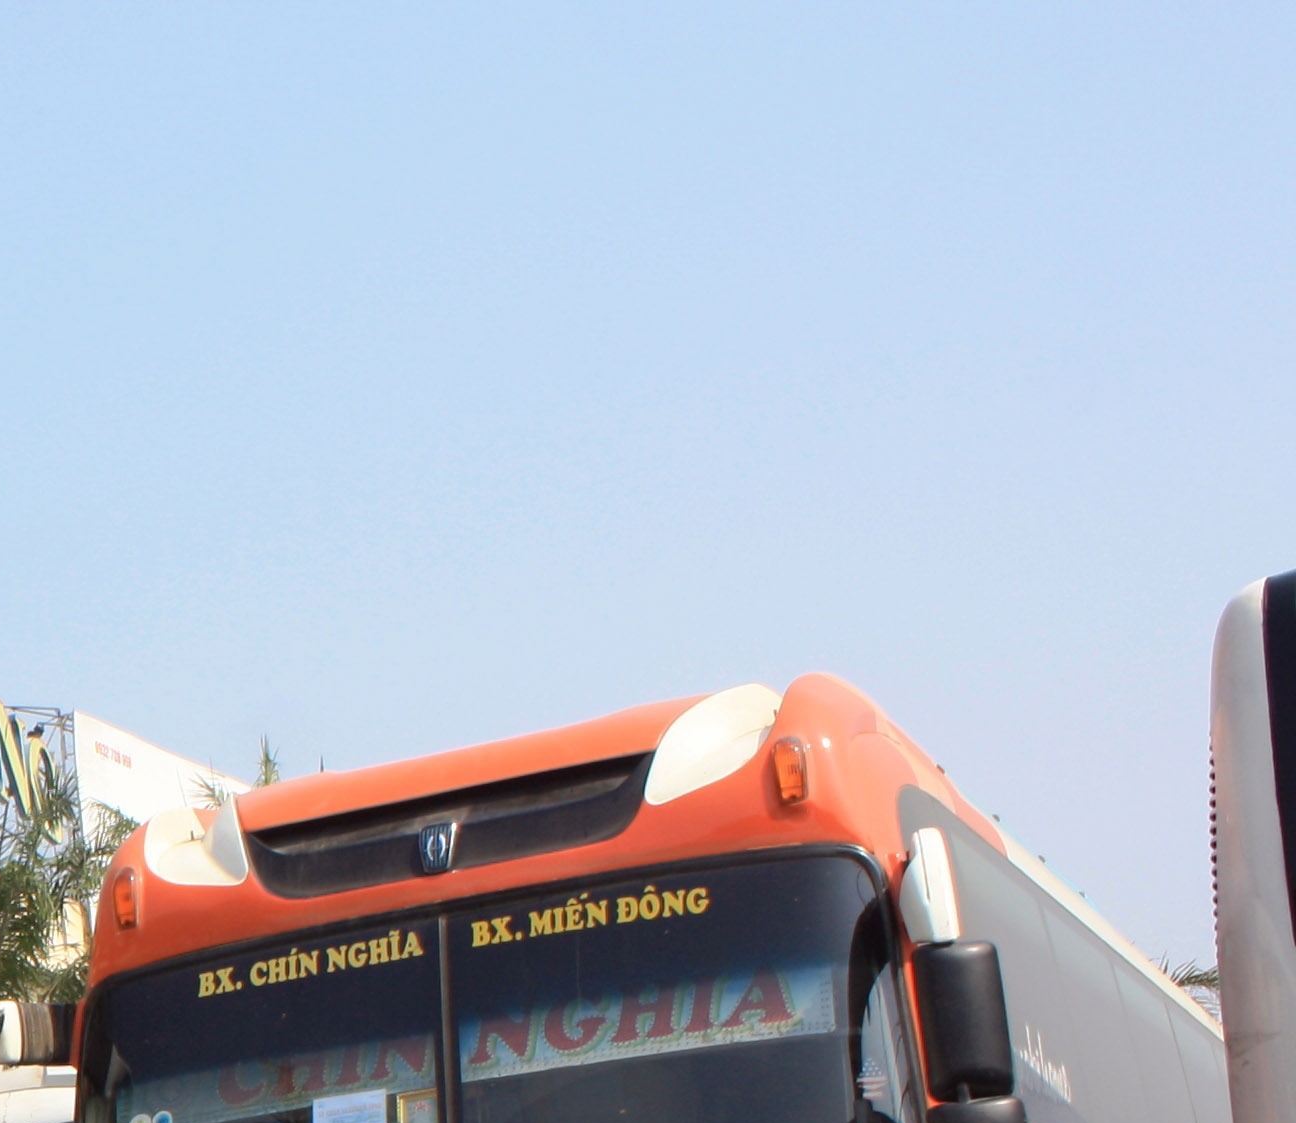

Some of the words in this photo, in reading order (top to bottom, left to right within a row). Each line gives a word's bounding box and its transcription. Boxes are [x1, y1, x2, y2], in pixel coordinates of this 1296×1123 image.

[471, 916, 522, 947] BX.
[616, 885, 710, 923] ĐÔNG
[198, 967, 242, 998] BX.
[249, 948, 319, 986] CHÍN
[326, 930, 424, 973] NGHĨA
